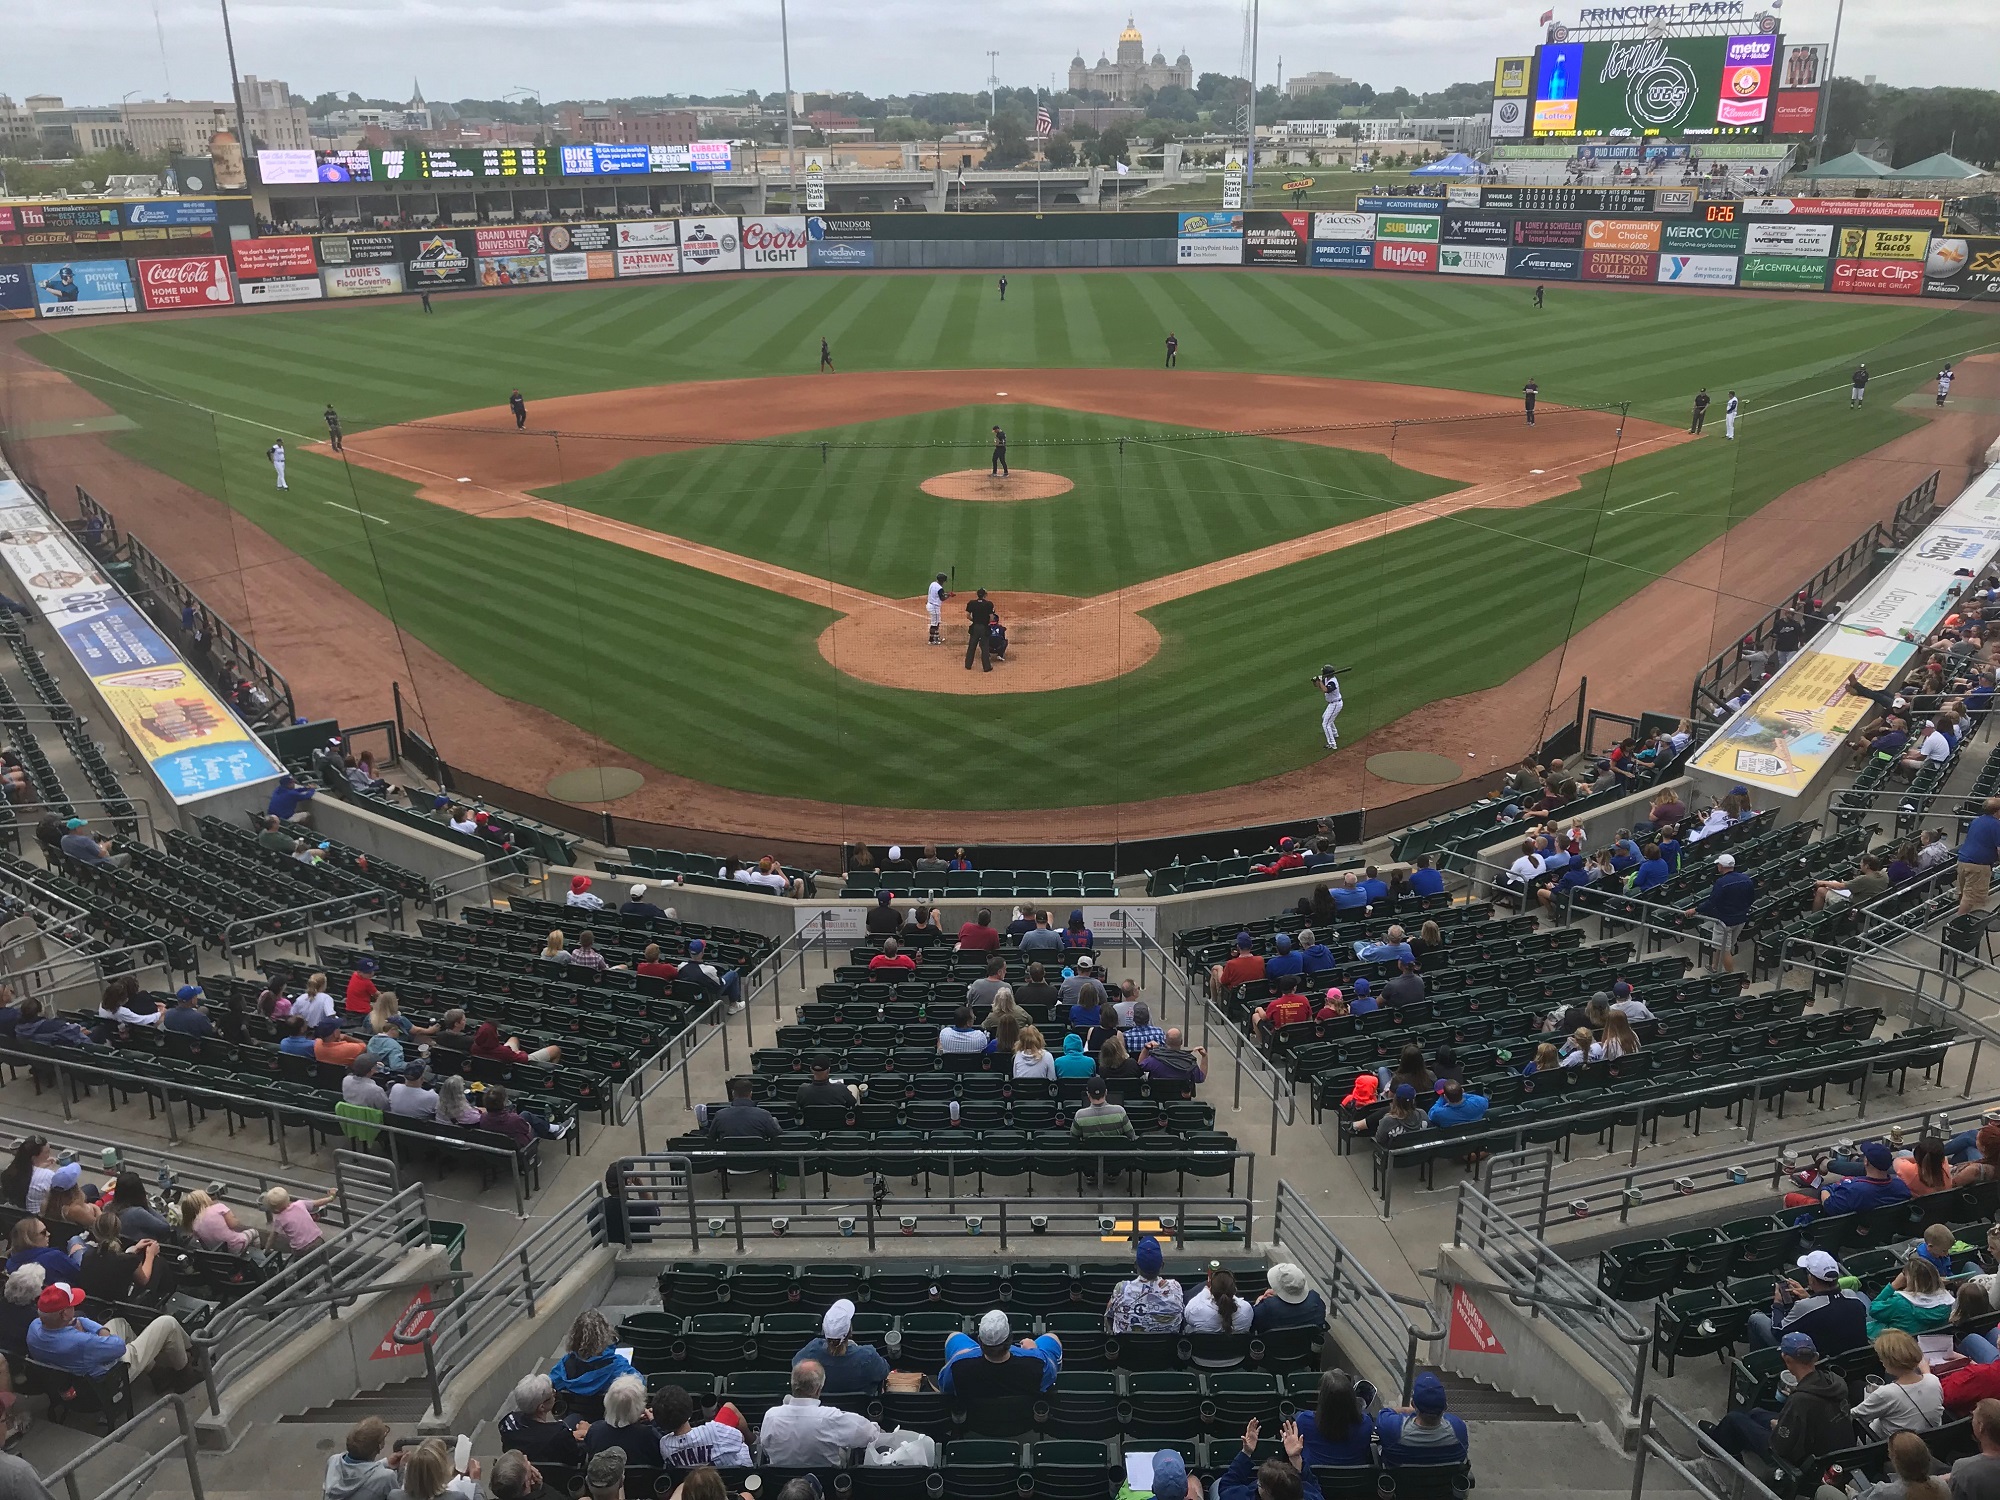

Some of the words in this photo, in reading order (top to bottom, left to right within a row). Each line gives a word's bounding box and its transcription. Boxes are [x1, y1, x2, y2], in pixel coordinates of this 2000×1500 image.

[1580, 4, 1681, 22] PRINCIPAL
[1688, 1, 1743, 17] PARK
[1731, 42, 1770, 54] metro
[667, 145, 687, 153] RAFFLE
[691, 144, 728, 152] CUBBIE'S
[1595, 149, 1607, 157] BUD
[1609, 148, 1628, 157] LIGHT
[382, 151, 405, 165] DUE
[564, 148, 594, 160] BIKE
[578, 160, 594, 168] THE
[387, 165, 404, 179] UP
[1662, 193, 1690, 204] LENZ
[21, 210, 45, 224] Hm
[78, 211, 100, 219] SEATS
[1707, 206, 1734, 222] 0:26
[1897, 208, 1939, 216] URBANDALE
[1326, 215, 1361, 224] access
[828, 220, 871, 231] WINDSOR
[1384, 222, 1433, 234] SUBWAY
[1549, 222, 1582, 231] SCHUELLER
[1609, 222, 1659, 232] Community
[477, 230, 505, 240] GRAND
[507, 229, 527, 239] VIEW
[743, 223, 807, 250] Coors
[1267, 229, 1296, 237] MONEY,
[1666, 227, 1739, 239] MERCYONE
[1876, 232, 1913, 243] Tasty
[27, 235, 70, 243] GOLDEN
[479, 239, 526, 250] UNIVERSITY
[1528, 235, 1575, 244] loneylaw.com
[1630, 242, 1650, 250] GOOD!
[1668, 241, 1737, 249] MercyOne.org/desmoines
[1875, 244, 1911, 252] Tacos
[755, 249, 797, 263] LIGHT
[818, 247, 866, 258] broadlawns
[1463, 251, 1480, 260] THE
[1483, 252, 1505, 261] IOWA
[437, 260, 466, 268] MEADOWS
[622, 253, 674, 265] FAREWAY
[1463, 260, 1494, 269] CLINIC
[1551, 260, 1572, 268] BEND
[1592, 253, 1650, 265] SIMPSON
[147, 261, 210, 284] Coca-Cola
[344, 267, 381, 278] LOUIE'S
[1590, 264, 1648, 276] COLLEGE
[1764, 264, 1800, 272] CENTRAL
[1801, 264, 1823, 273] BANK
[1836, 264, 1879, 278] Great
[1882, 266, 1919, 282] Clips
[85, 272, 118, 284] power
[336, 279, 357, 287] Floor
[358, 277, 391, 287] Covering
[1693, 272, 1733, 281] dmymca.org
[96, 281, 127, 292] hitter
[151, 287, 178, 296] HOME
[180, 286, 198, 294] RUN
[153, 296, 181, 304] TASTE
[56, 305, 74, 313] EMC
[1915, 535, 1968, 562] Smart
[1957, 543, 1985, 560] Honda
[1856, 587, 1918, 624] Visionary
